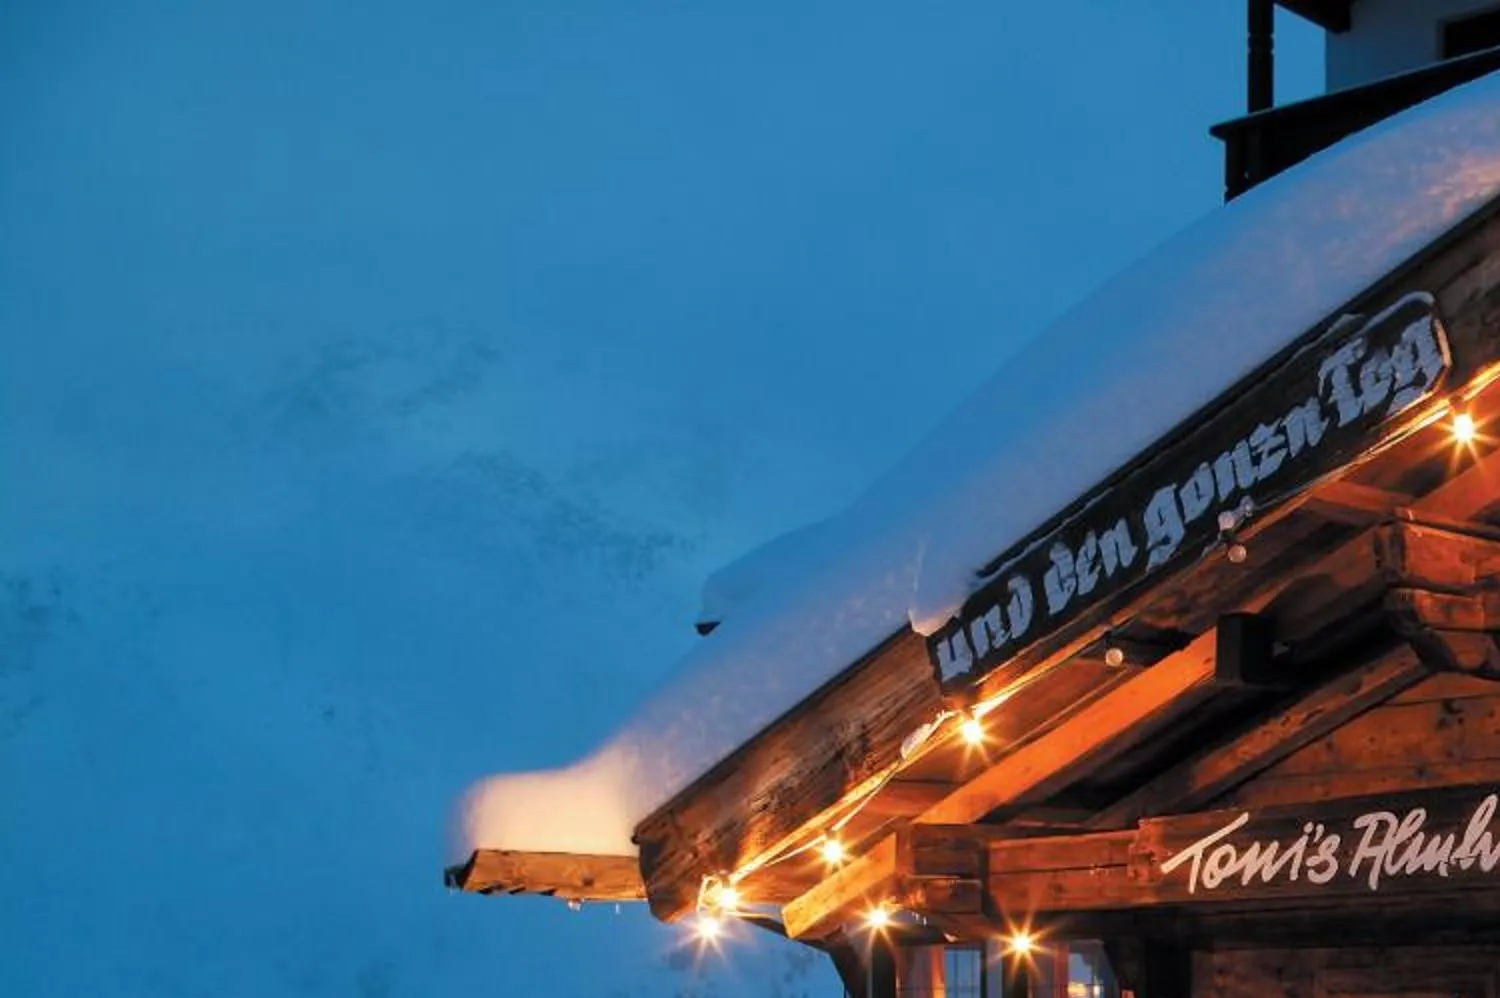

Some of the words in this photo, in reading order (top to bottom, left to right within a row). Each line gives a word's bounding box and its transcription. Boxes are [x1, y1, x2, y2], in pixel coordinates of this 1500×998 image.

[936, 575, 1034, 684] und
[1043, 517, 1139, 616] den
[1159, 811, 1342, 895] Toni's
